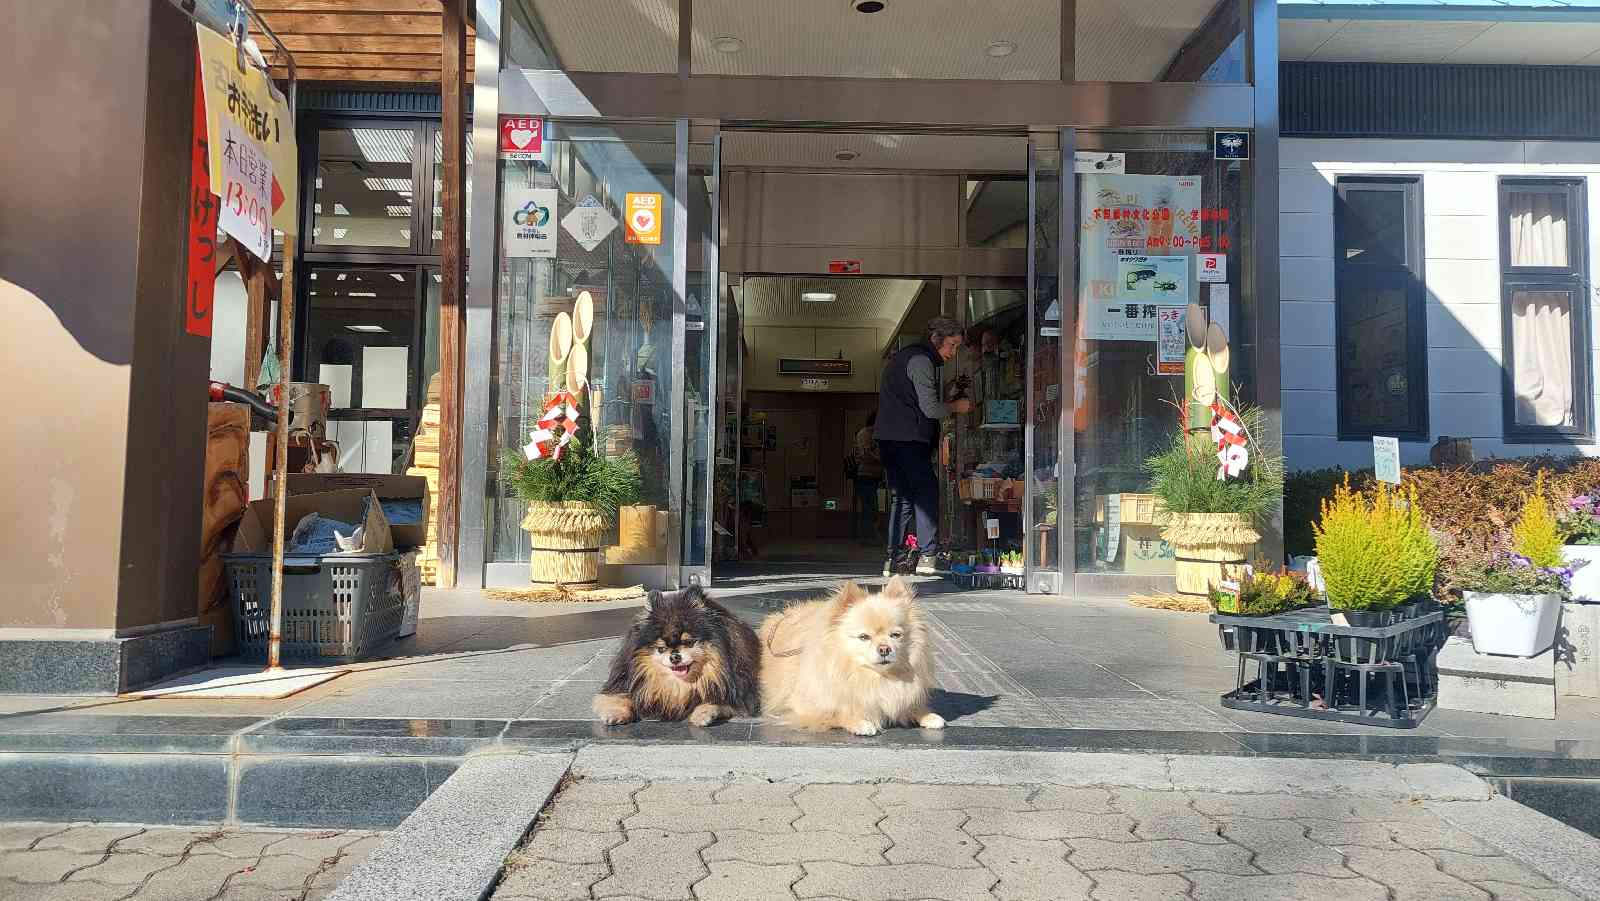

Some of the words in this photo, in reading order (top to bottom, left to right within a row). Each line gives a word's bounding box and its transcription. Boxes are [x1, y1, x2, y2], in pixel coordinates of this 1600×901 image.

[227, 82, 280, 144] お手洗い
[504, 119, 540, 129] AED
[225, 180, 269, 234] 13:00
[632, 196, 657, 205] AED
